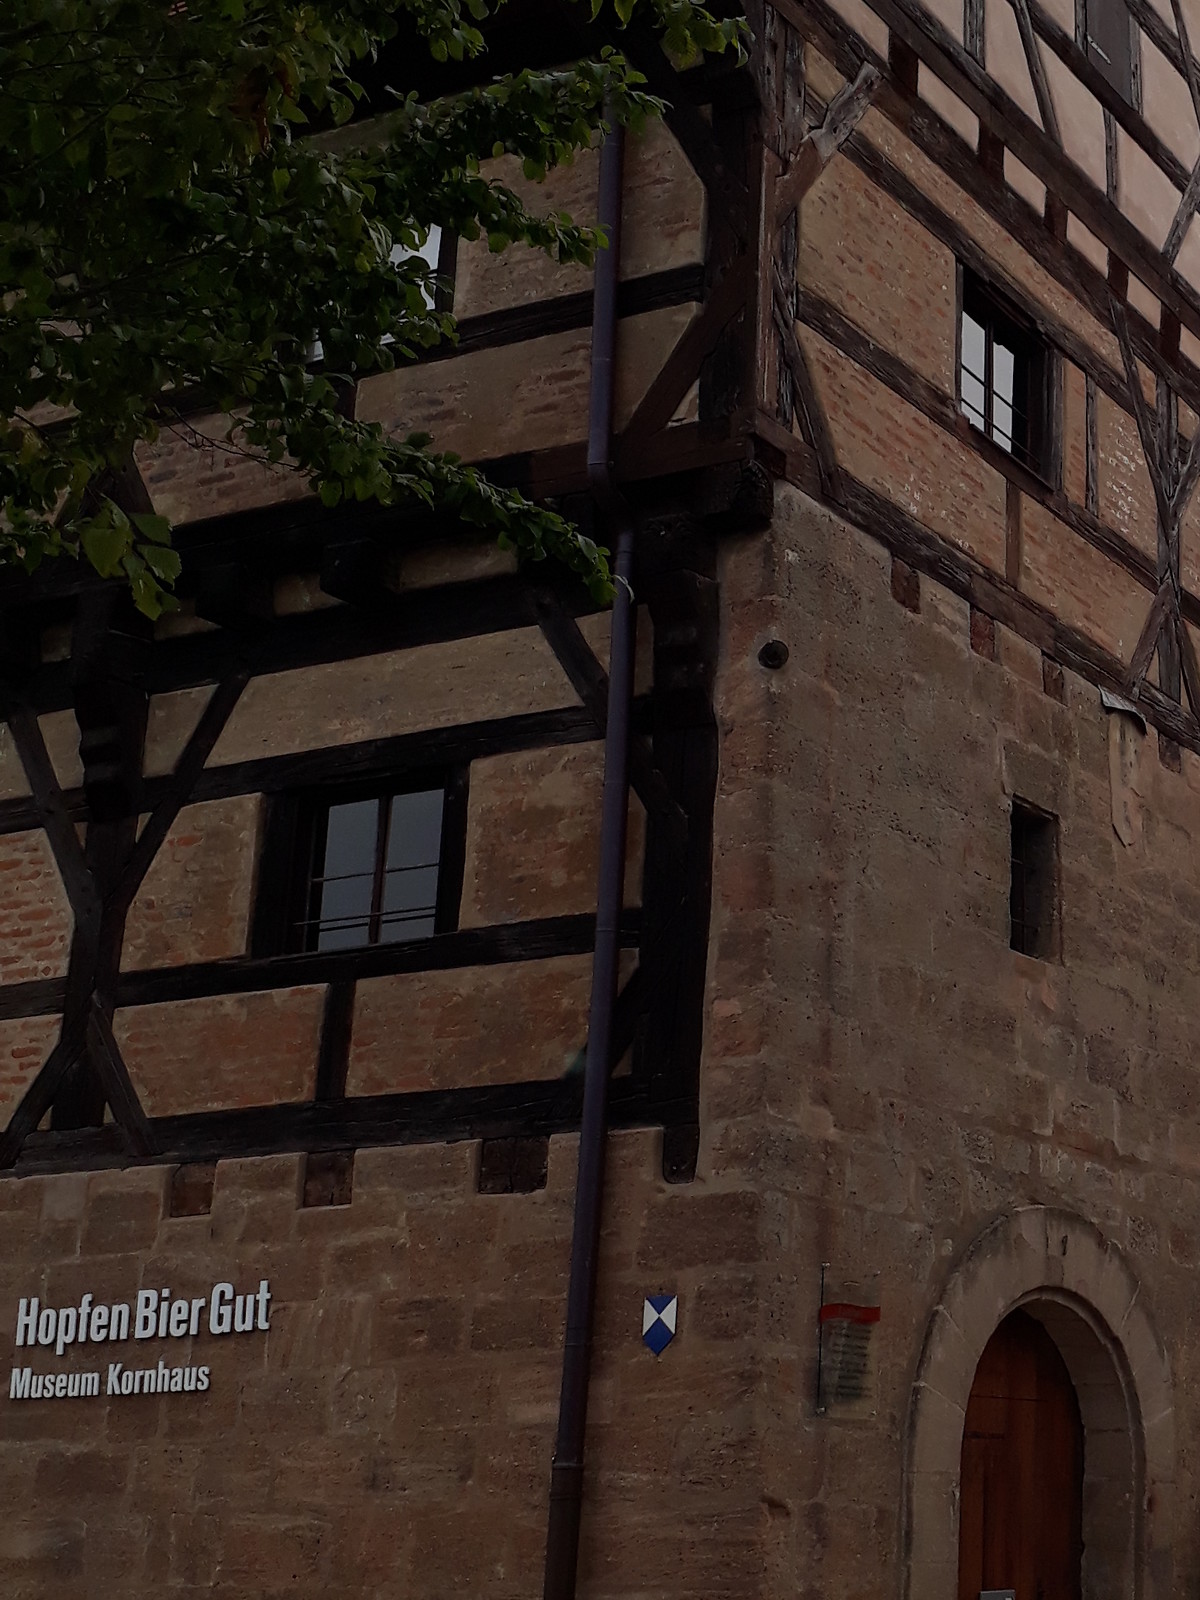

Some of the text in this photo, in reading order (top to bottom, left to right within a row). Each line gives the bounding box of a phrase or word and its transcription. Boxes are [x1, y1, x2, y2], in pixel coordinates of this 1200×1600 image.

[15, 1279, 272, 1356] Hopfen Bier Gut
[9, 1360, 210, 1399] Museum Kornhaus
